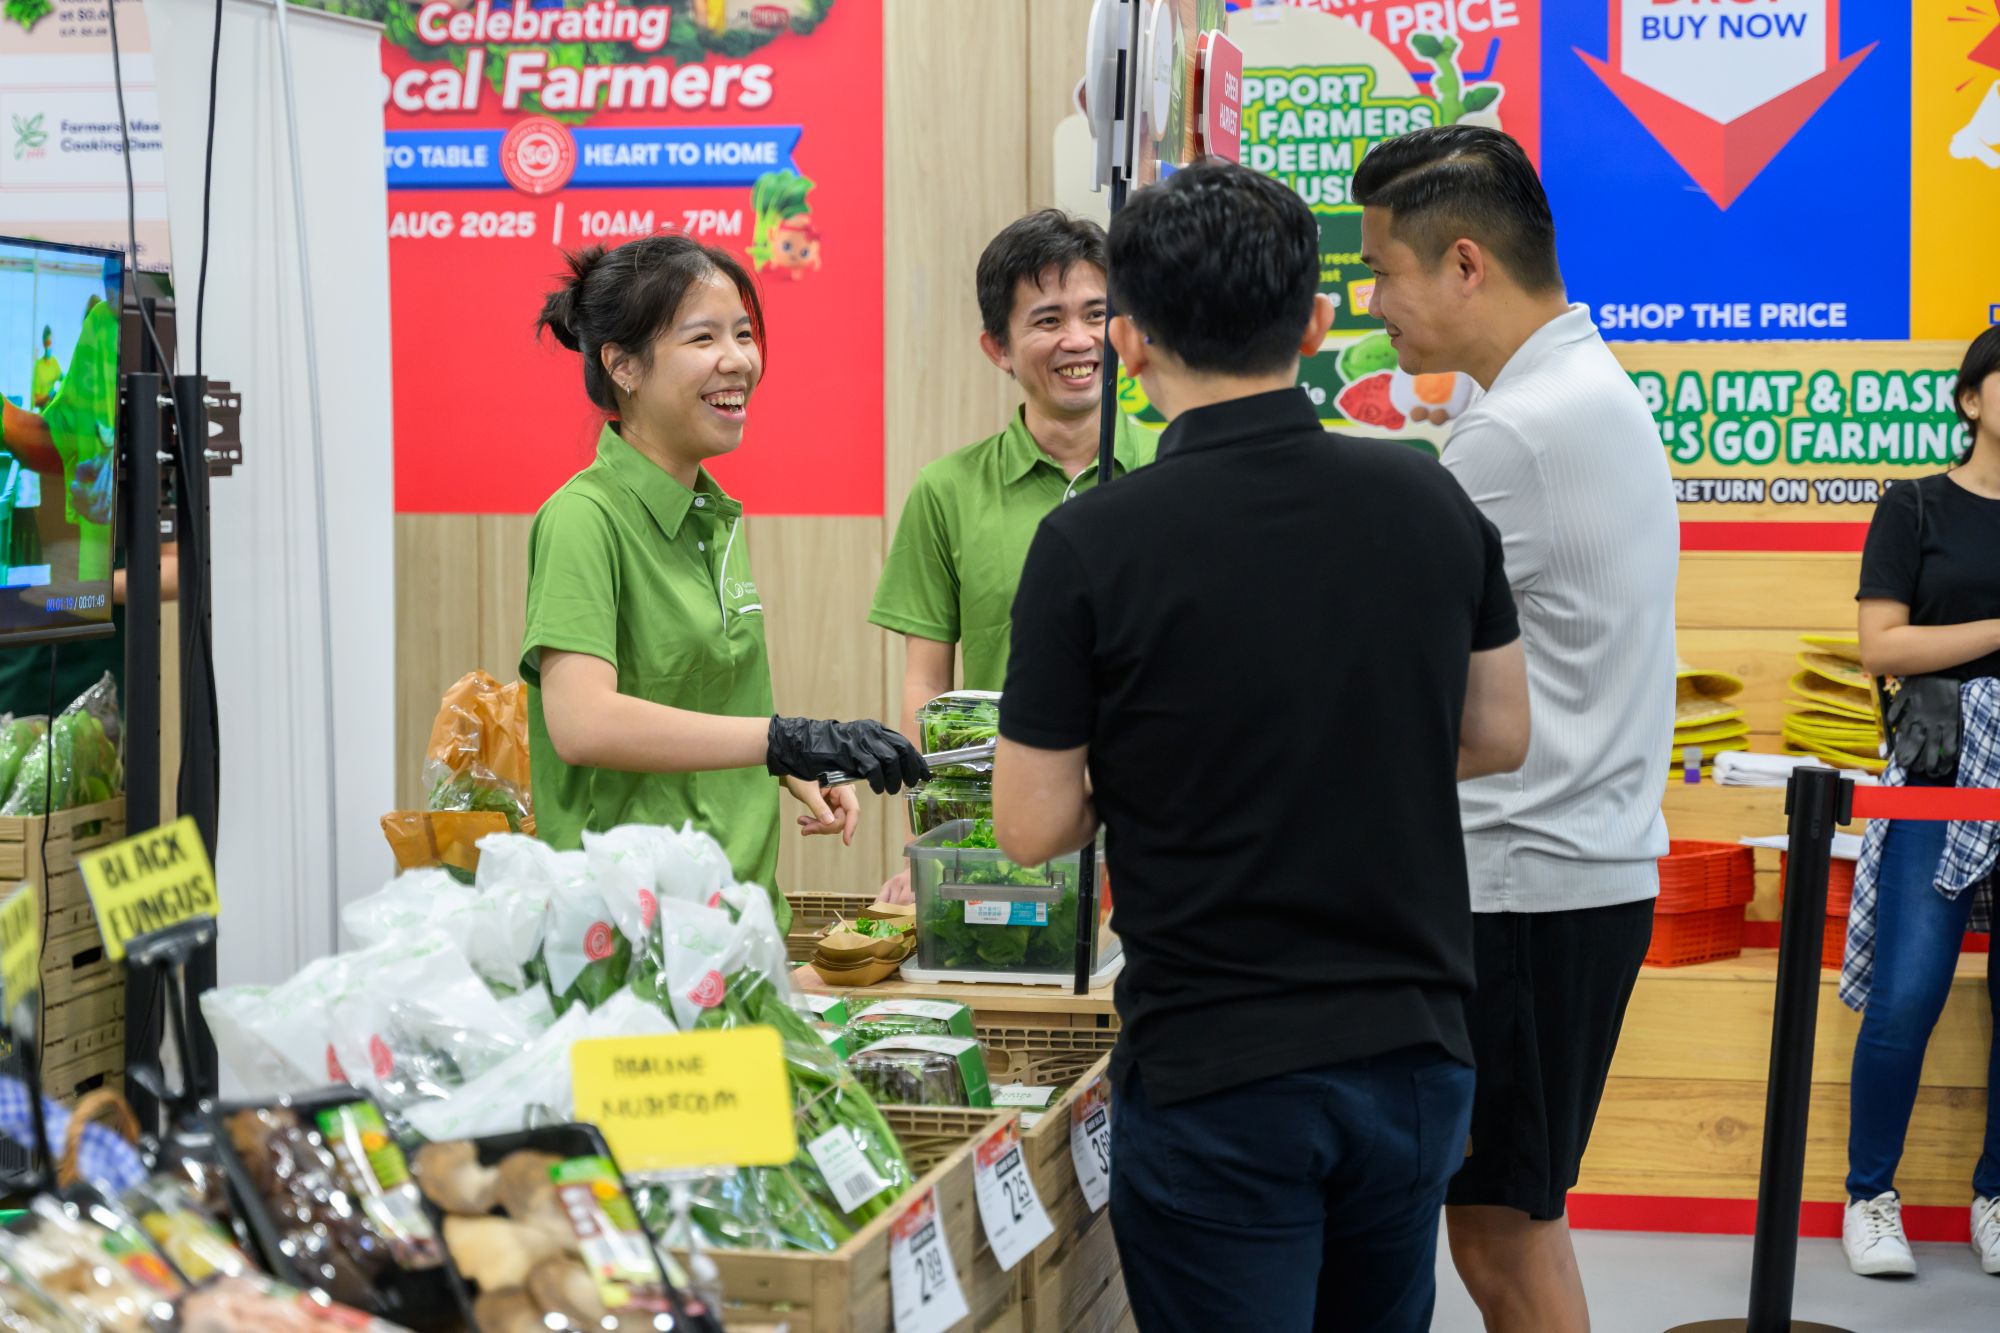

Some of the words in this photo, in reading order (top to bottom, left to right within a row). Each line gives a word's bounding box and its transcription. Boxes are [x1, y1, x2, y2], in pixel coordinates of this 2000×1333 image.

[418, 0, 668, 48] Celebrating
[1386, 0, 1519, 44] PRICE
[1641, 15, 1707, 40] BUY
[1719, 13, 1807, 38] NOW
[502, 51, 773, 110] Farmers
[1225, 70, 1239, 103] GREEN
[1219, 102, 1238, 138] HARVEST
[1259, 106, 1433, 139] FARMERS
[418, 145, 488, 168] TABLE
[583, 143, 660, 166] HEART
[664, 142, 700, 166] TO
[703, 141, 779, 165] HOME
[388, 211, 455, 239] AUG
[459, 211, 537, 238] 2025
[578, 209, 655, 237] 10AM
[681, 208, 743, 236] 7PM
[1600, 303, 1684, 330] SHOP
[1691, 302, 1751, 329] THE
[1760, 302, 1848, 328] PRICE
[1119, 376, 1136, 400] 2
[1676, 375, 1705, 412] A
[1715, 375, 1797, 413] HAT
[1809, 375, 1842, 415] &
[1713, 420, 1777, 461] GO
[1791, 421, 1975, 459] FARMING
[1673, 479, 1765, 502] RETURN
[1770, 479, 1808, 502] ON
[1815, 480, 1879, 502] YOUR
[99, 832, 187, 889] BLACK
[108, 874, 212, 943] FUNGUS
